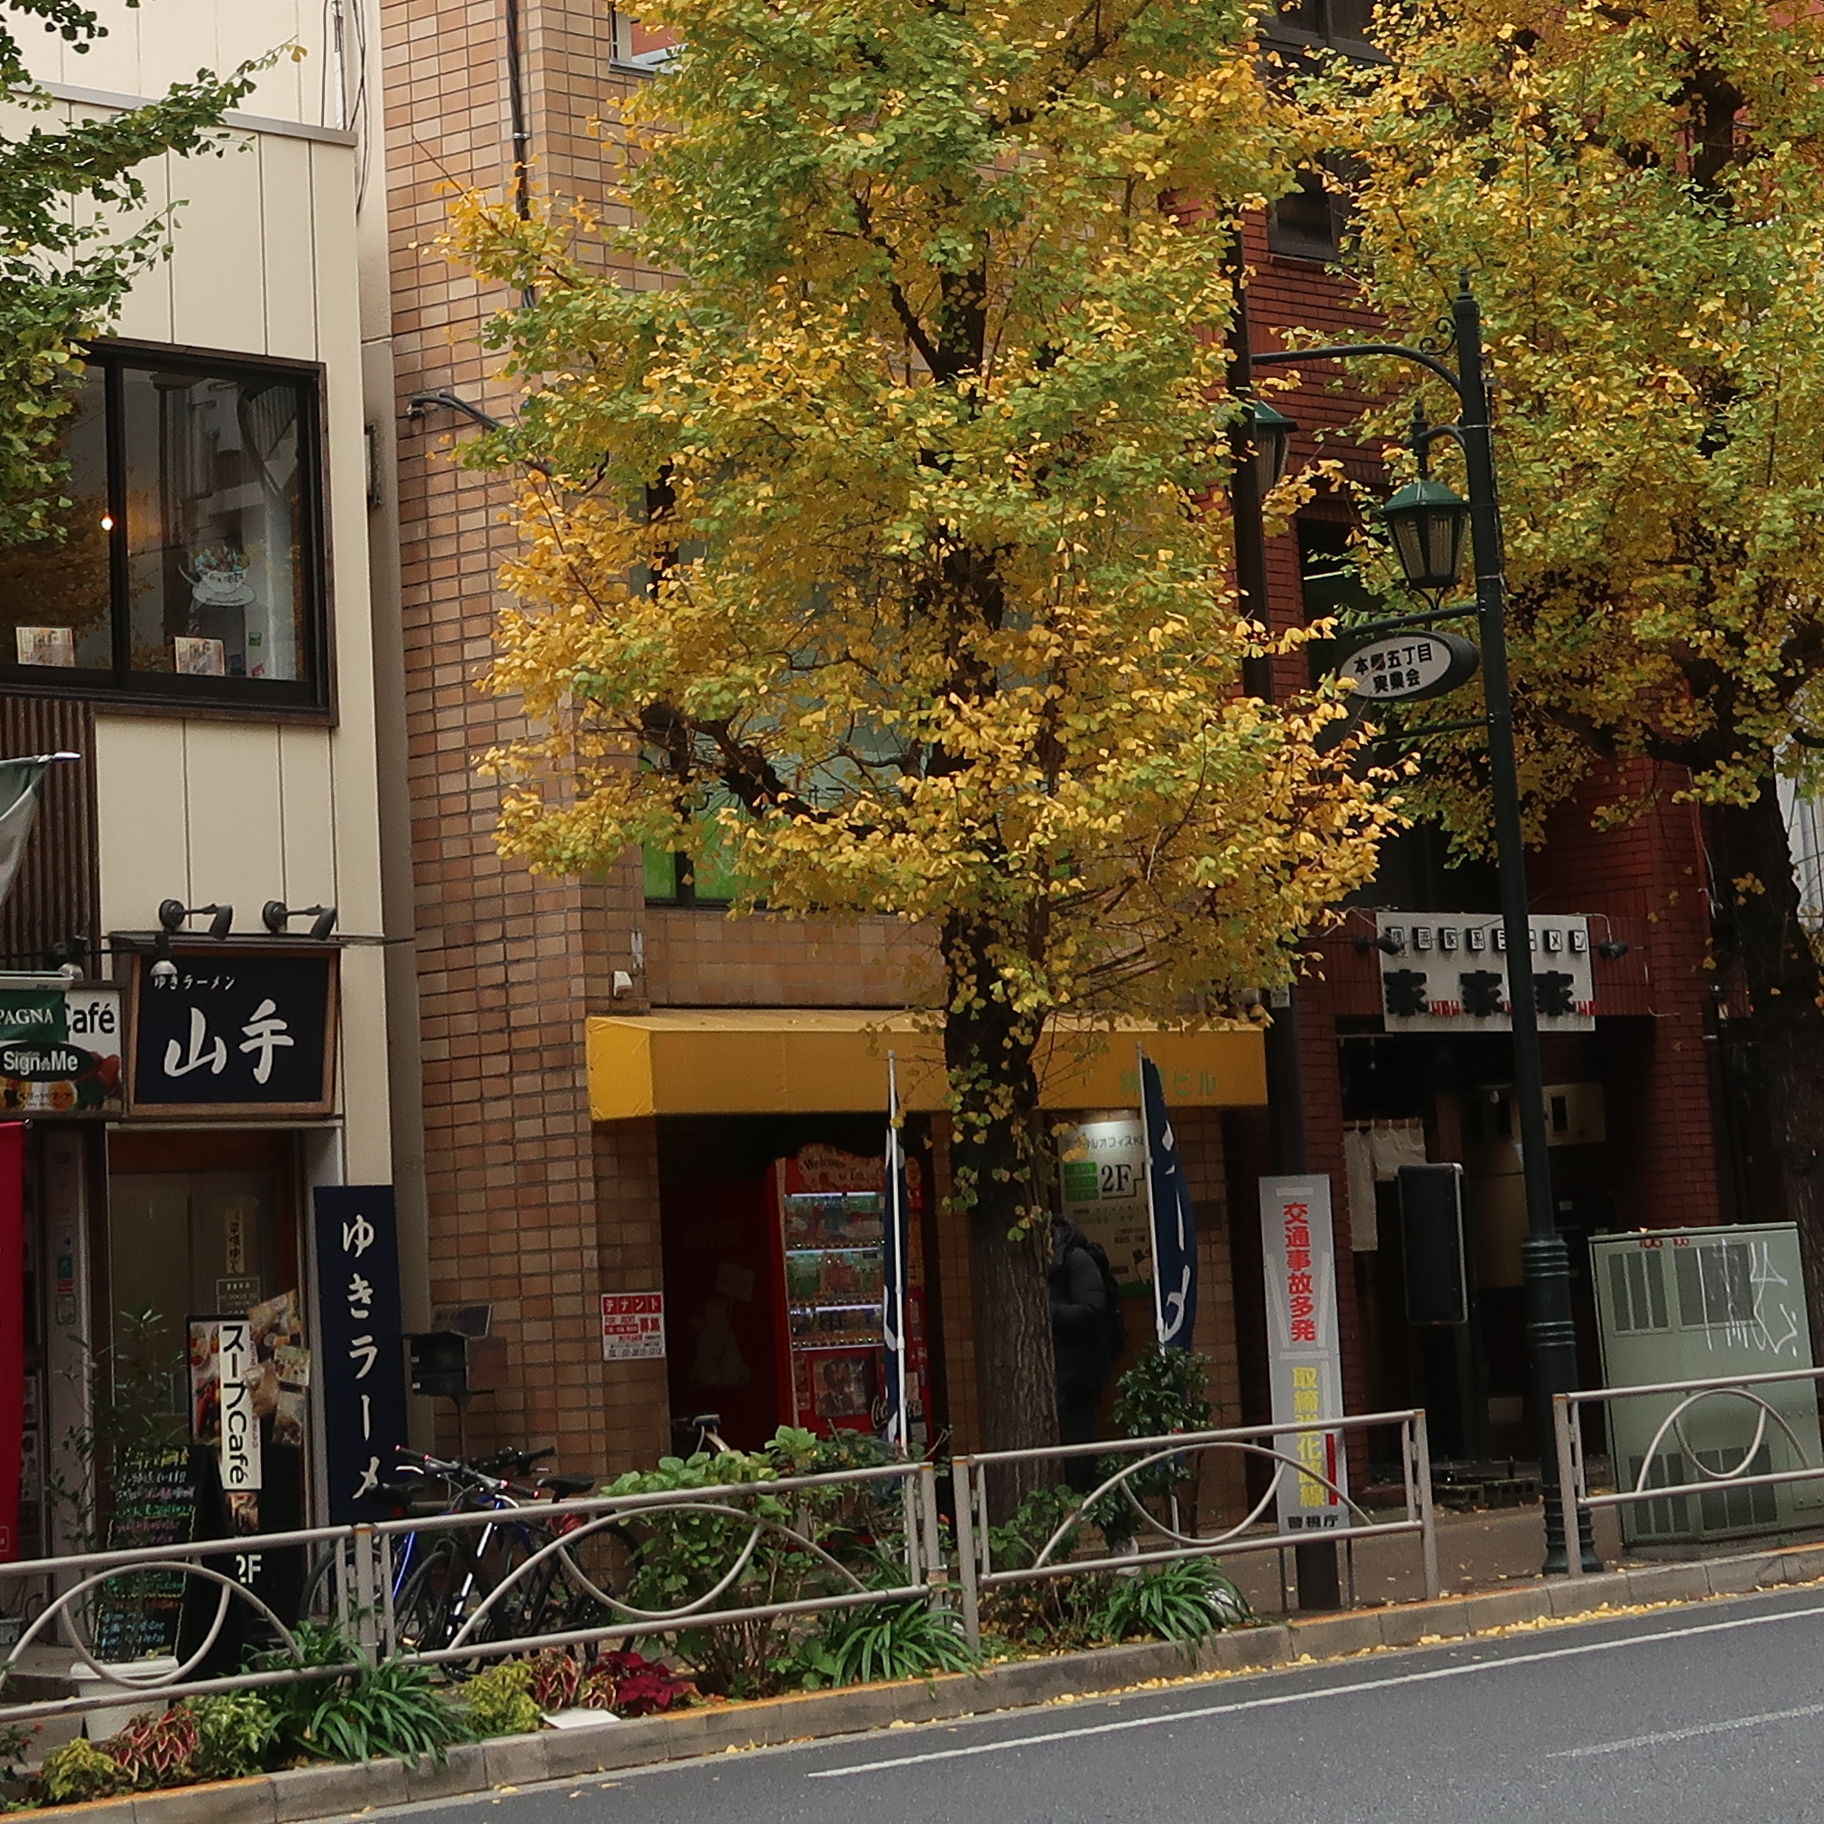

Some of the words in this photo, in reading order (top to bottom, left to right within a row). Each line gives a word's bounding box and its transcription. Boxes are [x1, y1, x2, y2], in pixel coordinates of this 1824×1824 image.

[162, 997, 296, 1086] 山手
[50, 1049, 79, 1072] Me
[1101, 1163, 1133, 1193] 2F
[1282, 1202, 1318, 1343] 交通事故多発
[606, 1298, 658, 1312] テナント
